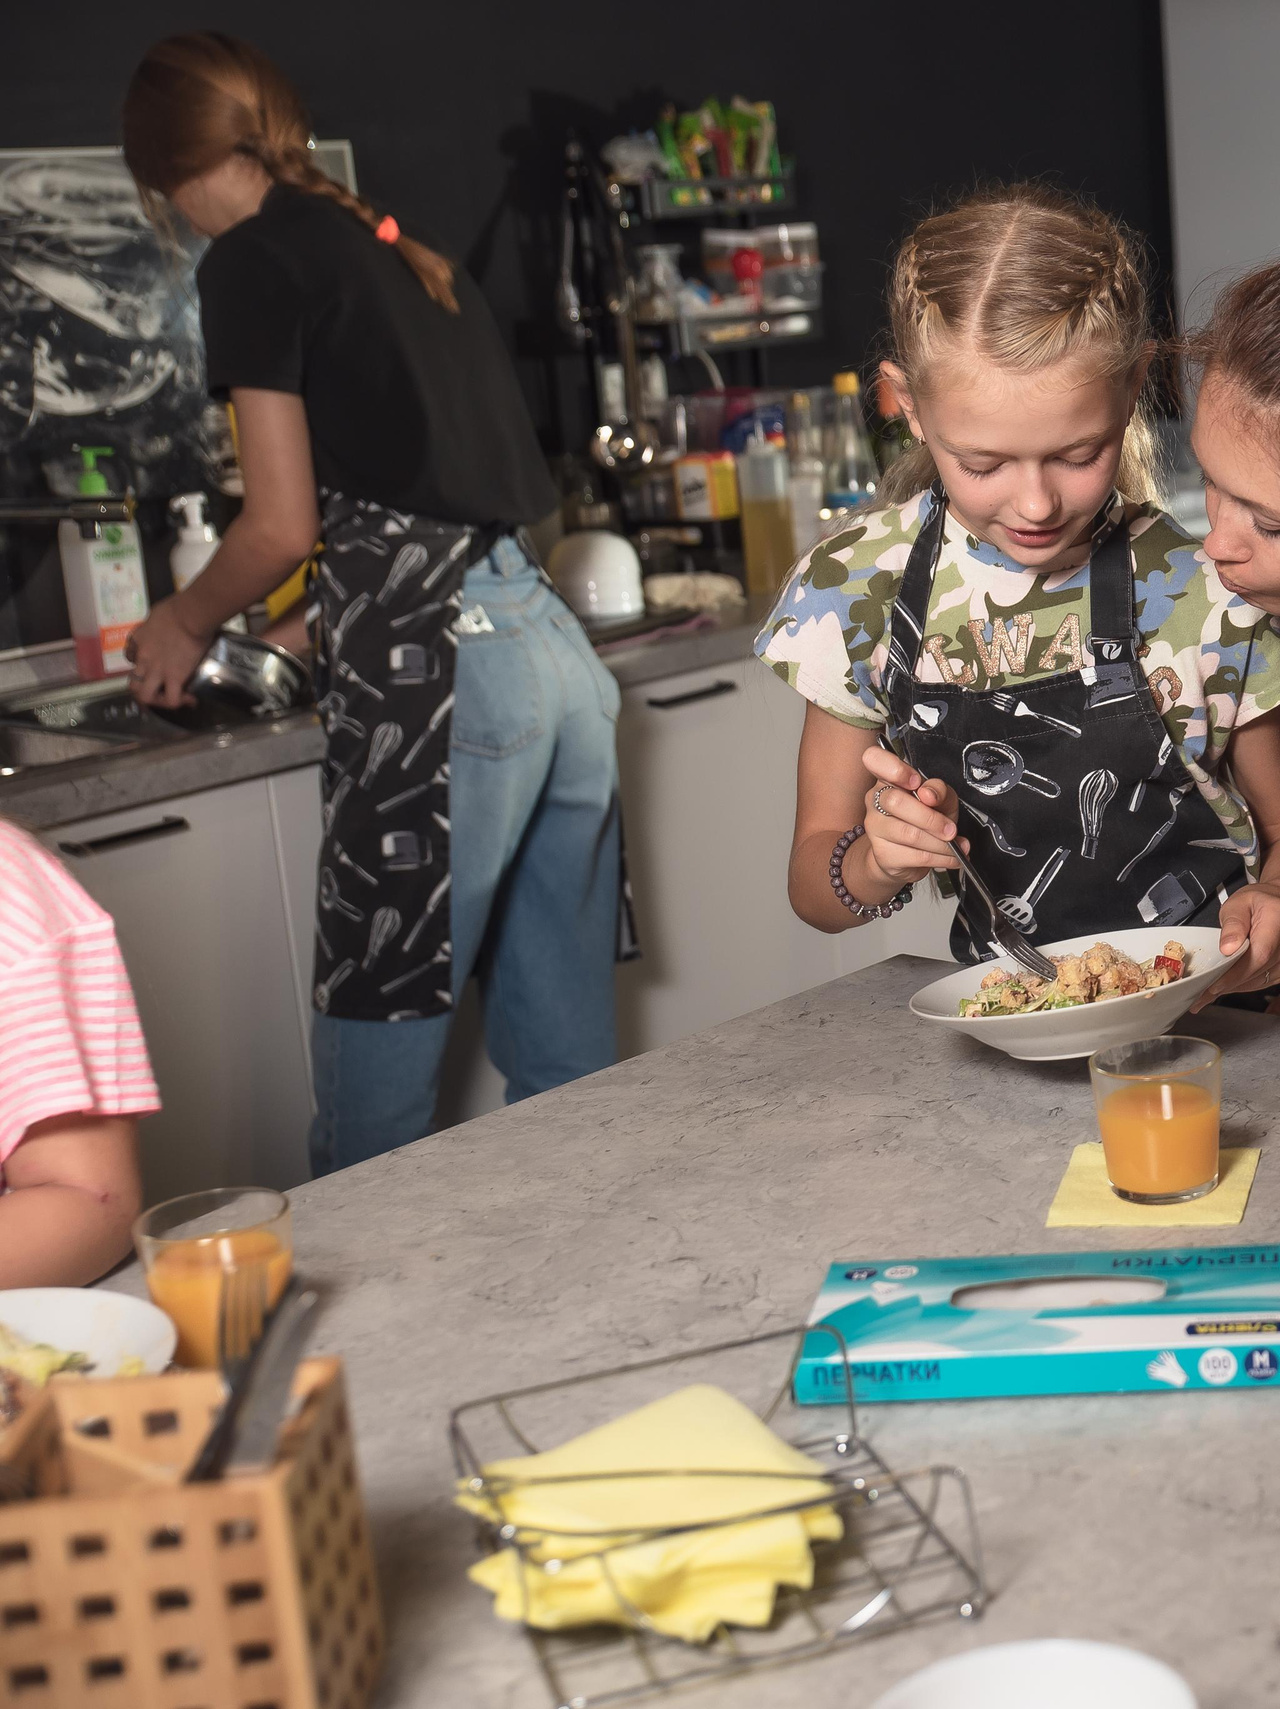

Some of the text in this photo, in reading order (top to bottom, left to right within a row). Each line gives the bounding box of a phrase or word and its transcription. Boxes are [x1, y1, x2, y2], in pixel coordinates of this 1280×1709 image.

[913, 612, 1184, 714] LWAS
[1112, 1252, 1280, 1268] ПЕРЧАТКИ
[1204, 1355, 1231, 1369] 100
[813, 1360, 941, 1386] ПЕРЧАТКИ
